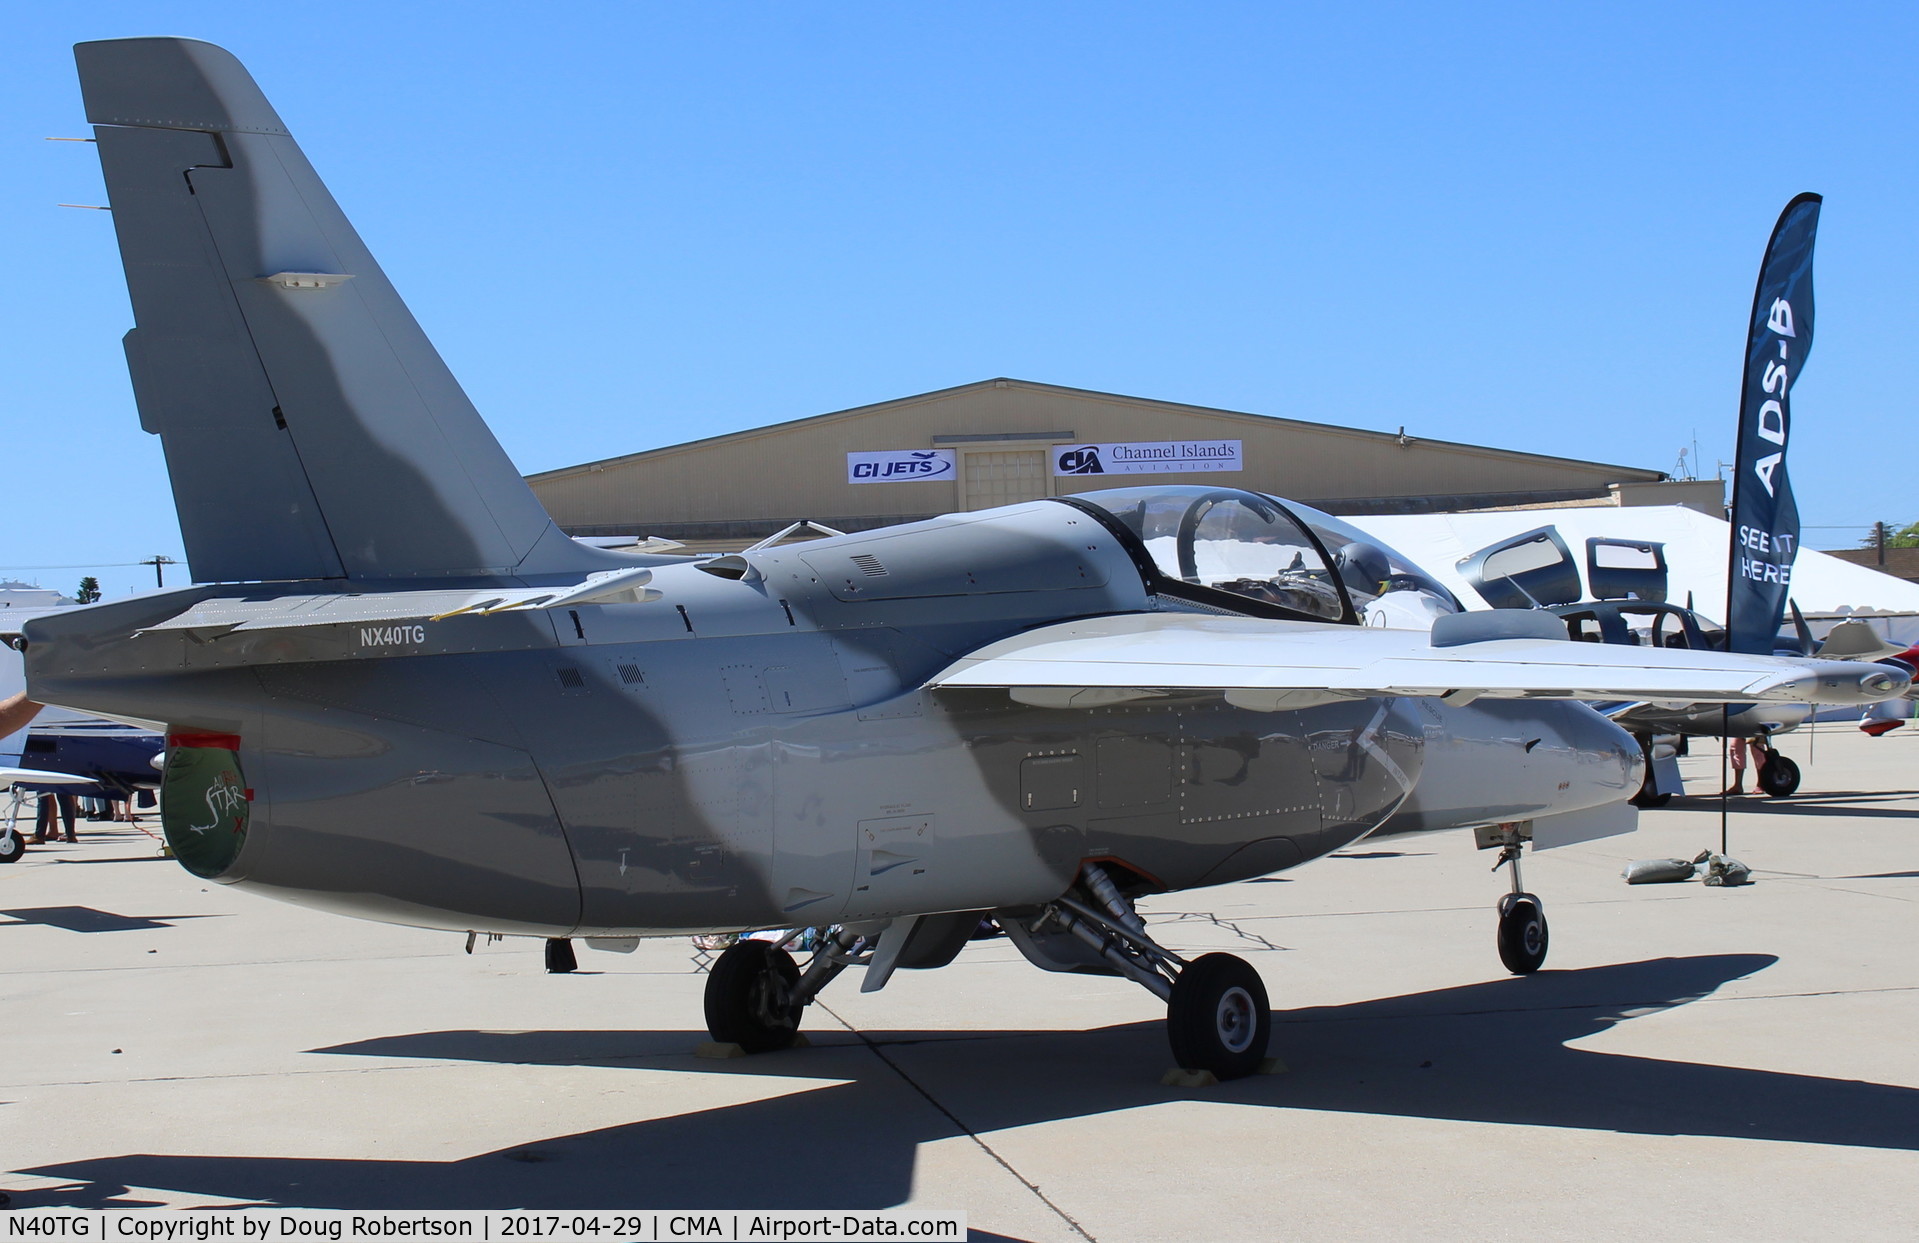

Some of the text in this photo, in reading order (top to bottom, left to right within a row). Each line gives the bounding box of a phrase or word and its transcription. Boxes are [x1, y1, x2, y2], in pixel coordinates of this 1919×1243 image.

[1755, 296, 1796, 498] ADS-B
[1058, 448, 1104, 474] CIA
[1112, 443, 1235, 460] Channel Islands
[853, 461, 933, 478] CI JETS
[1125, 462, 1225, 472] AVIATION
[1740, 525, 1794, 553] SEE IT
[360, 625, 425, 647] NX40TG
[1313, 740, 1340, 752] DANGER
